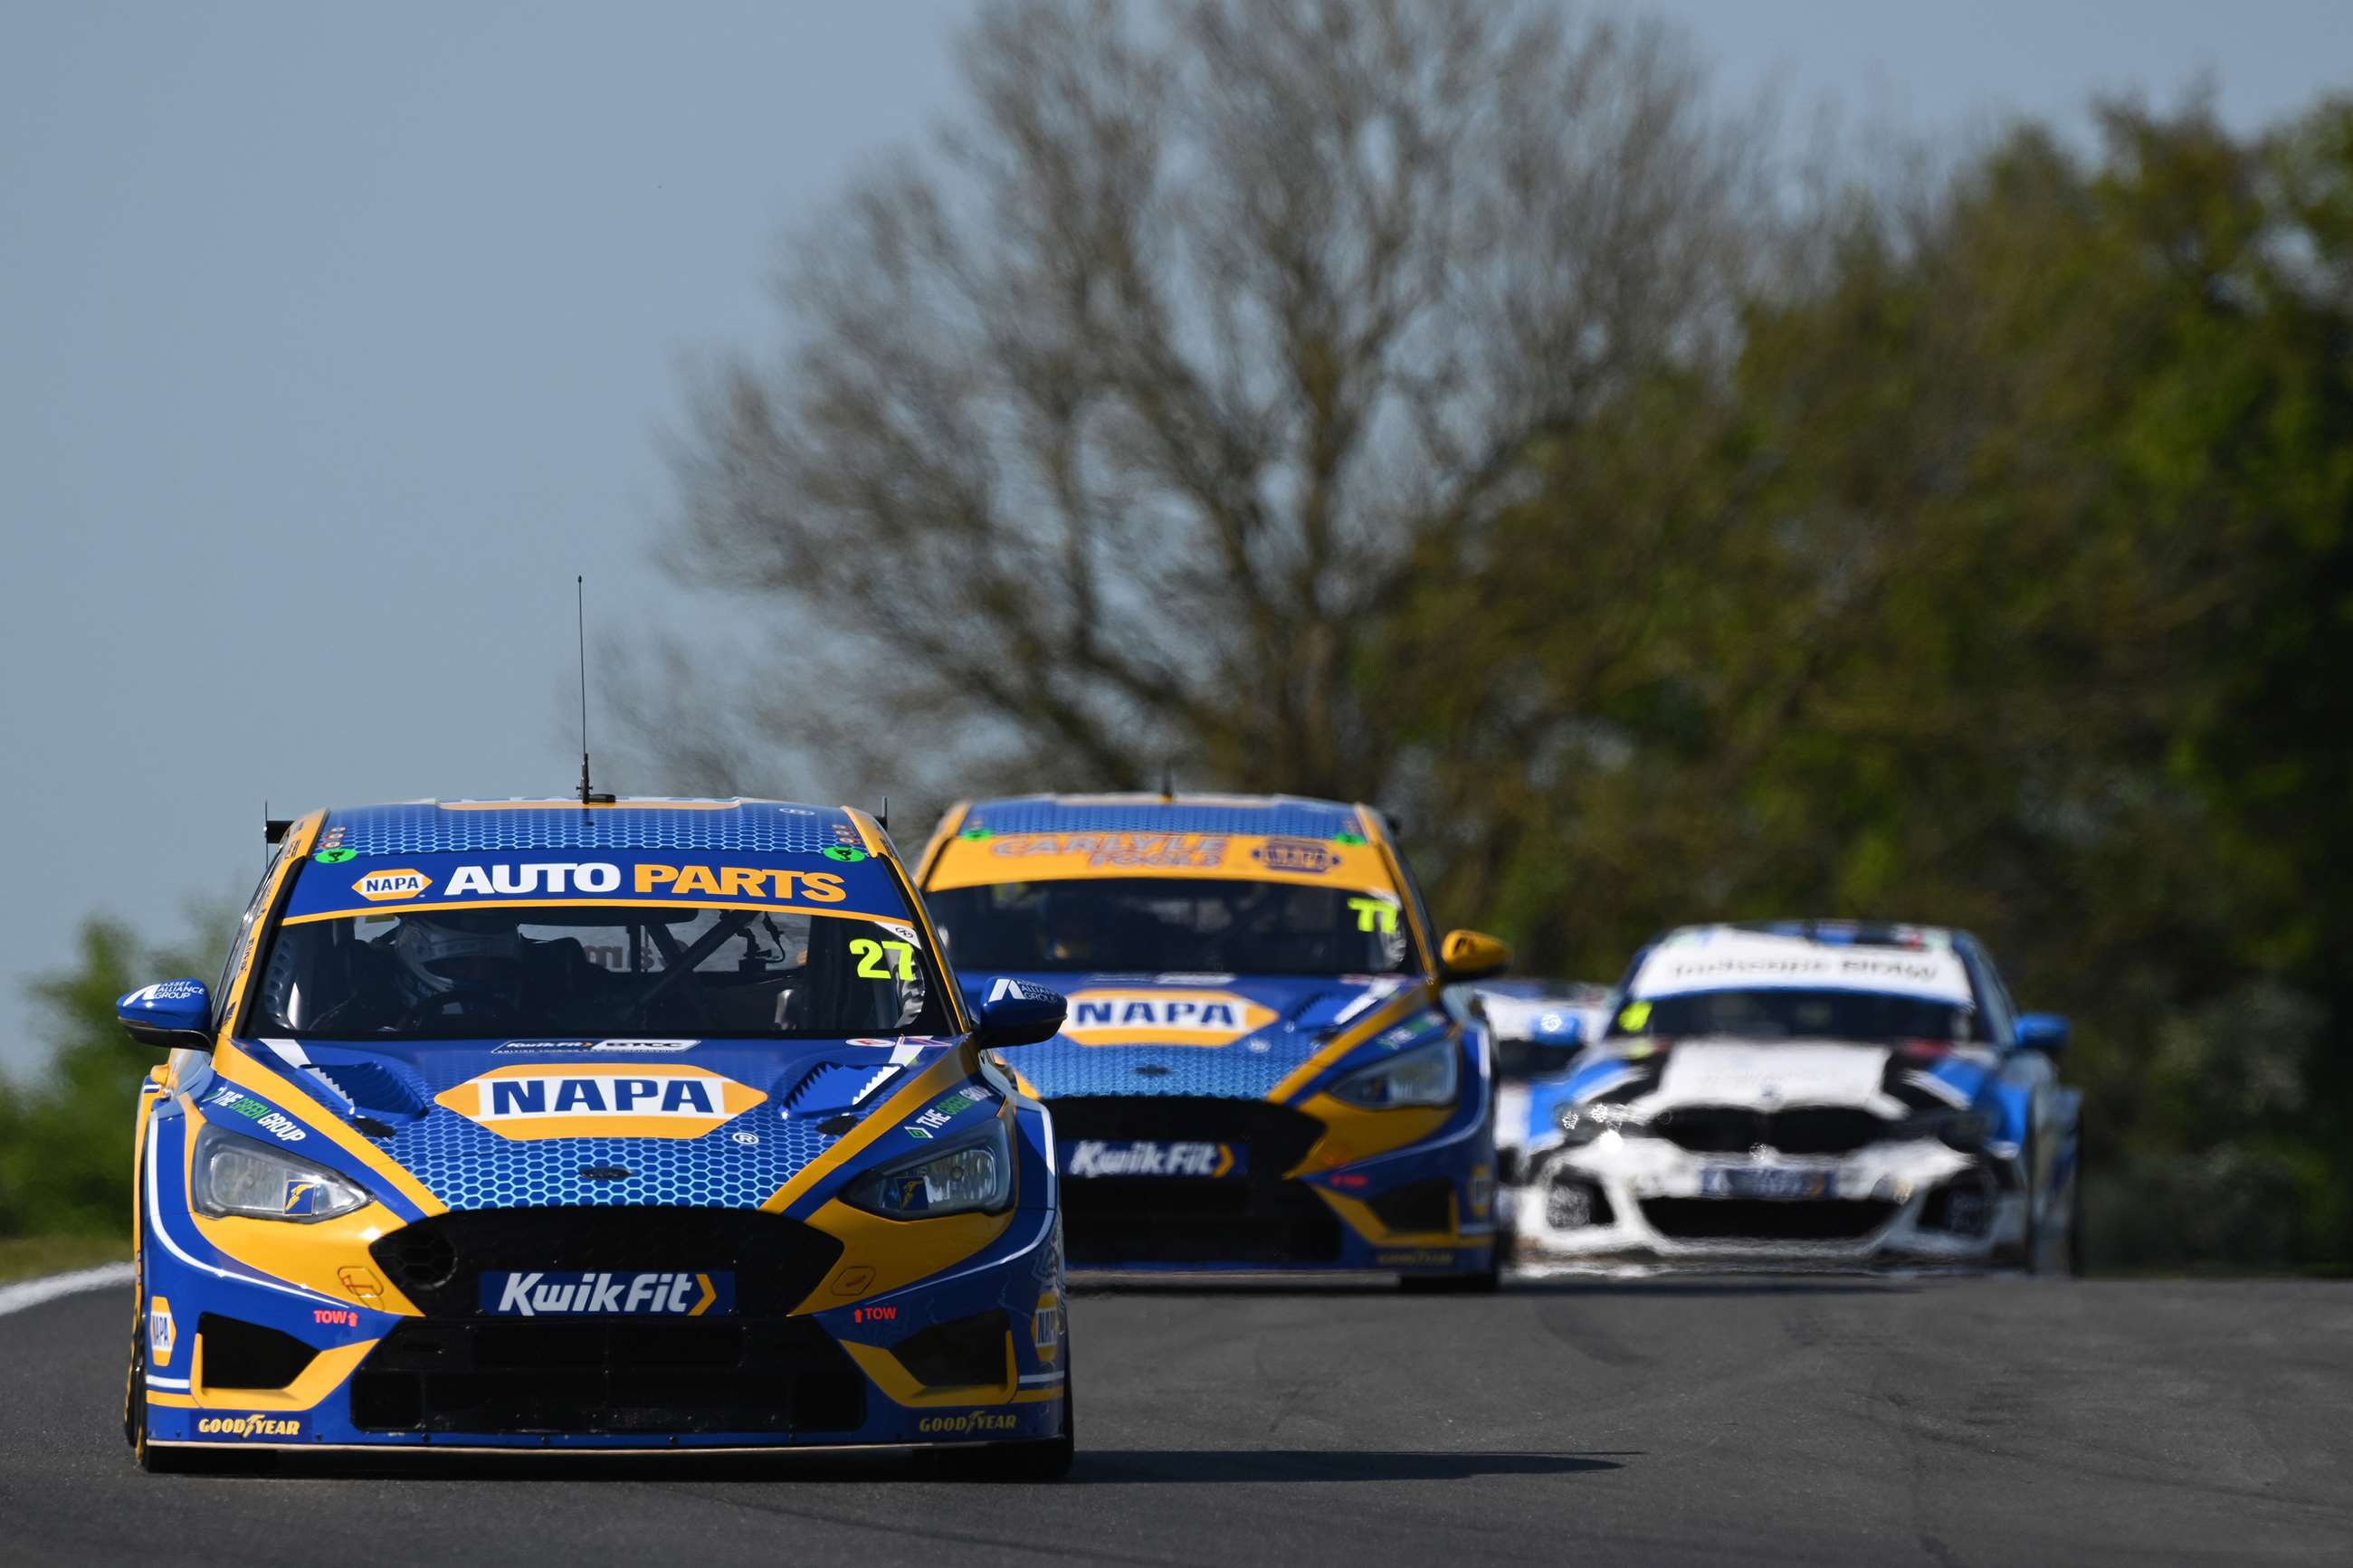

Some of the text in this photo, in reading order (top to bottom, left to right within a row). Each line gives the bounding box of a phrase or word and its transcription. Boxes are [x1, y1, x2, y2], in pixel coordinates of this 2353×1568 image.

[366, 862, 847, 903] NAPA AUTO PARTS
[1347, 897, 1398, 935] 77
[849, 938, 917, 982] 27
[154, 992, 191, 1000] GROUP
[157, 985, 205, 994] ALLIANCE
[1077, 1002, 1234, 1026] NAPA
[492, 1079, 715, 1116] NAPA
[211, 1090, 307, 1142] THE GREEN GROUP
[915, 1108, 952, 1129] THE
[313, 1309, 348, 1324] TOW
[865, 1307, 897, 1320] TOW
[198, 1414, 300, 1439] GOODYEAR
[919, 1411, 1017, 1434] GOODYEAR
